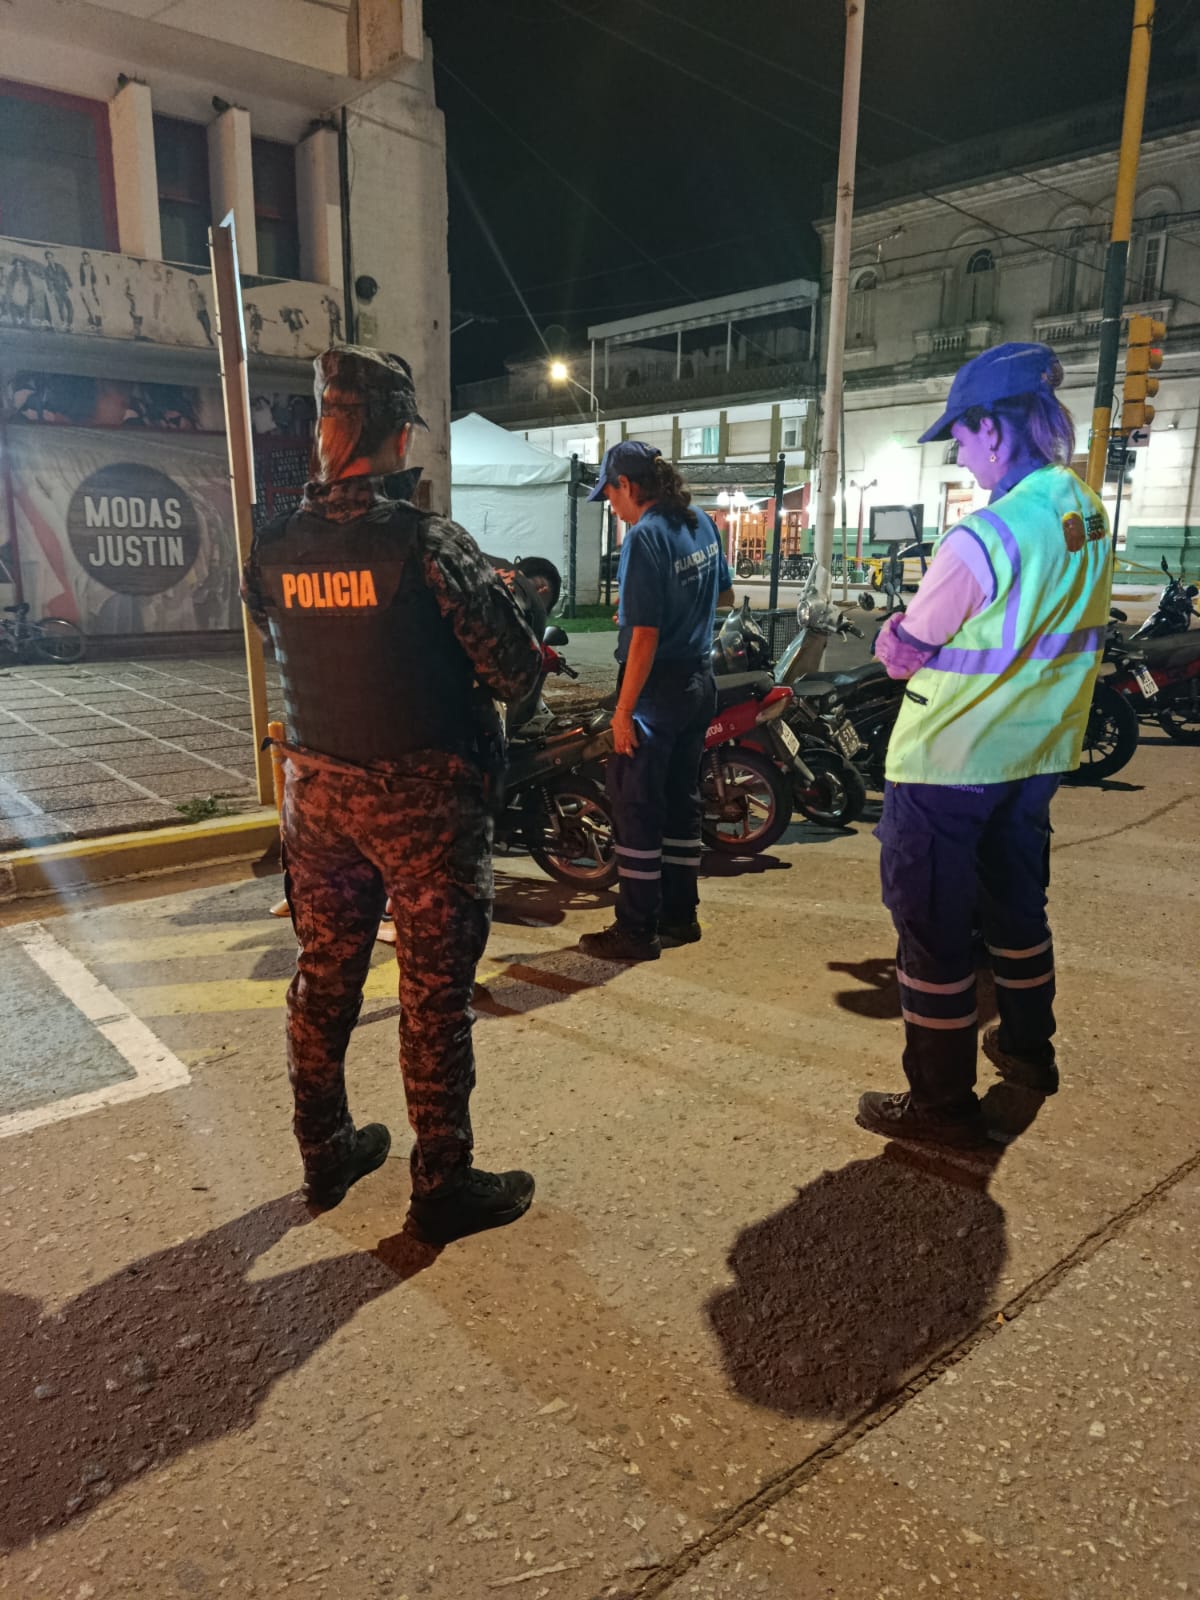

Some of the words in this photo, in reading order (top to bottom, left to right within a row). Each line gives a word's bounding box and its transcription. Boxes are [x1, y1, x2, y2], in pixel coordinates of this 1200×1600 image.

[84, 495, 182, 529] MODAS
[89, 535, 185, 567] JUSTIN
[281, 569, 378, 609] POLICIA
